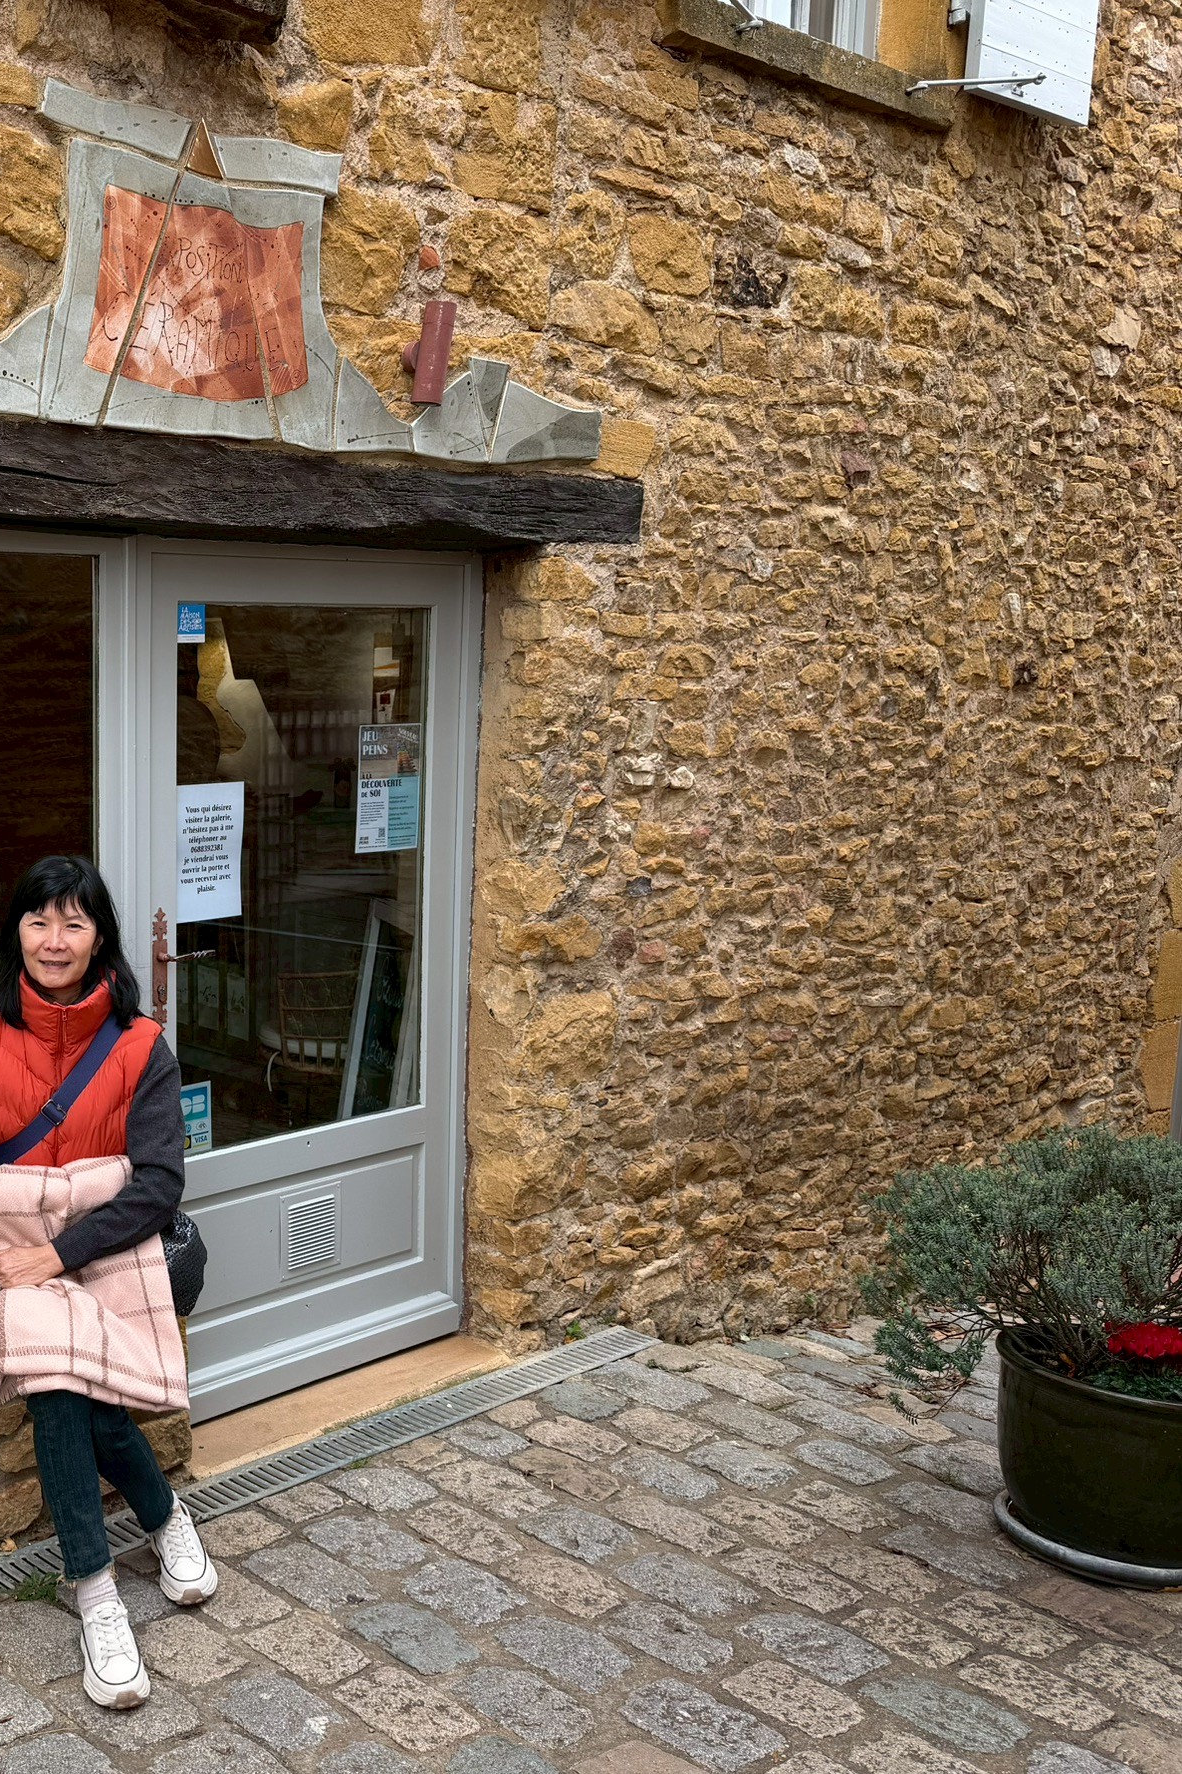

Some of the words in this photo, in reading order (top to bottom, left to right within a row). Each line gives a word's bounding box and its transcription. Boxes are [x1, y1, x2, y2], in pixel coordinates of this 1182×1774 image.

[362, 730, 379, 742] JEU
[362, 744, 388, 756] PEINS
[369, 789, 381, 798] SOI
[185, 806, 200, 814] Vous
[201, 805, 211, 814] qui
[212, 804, 232, 812] désirez
[211, 814, 232, 823] galerie,
[182, 825, 208, 834] n'hésitez
[188, 835, 218, 844] téléphoner
[183, 857, 190, 865] je
[191, 854, 215, 863] viendrai
[181, 866, 200, 874] ouvrir
[208, 864, 223, 873] porte
[195, 874, 218, 882] recevrai
[194, 1135, 208, 1144] VISA
